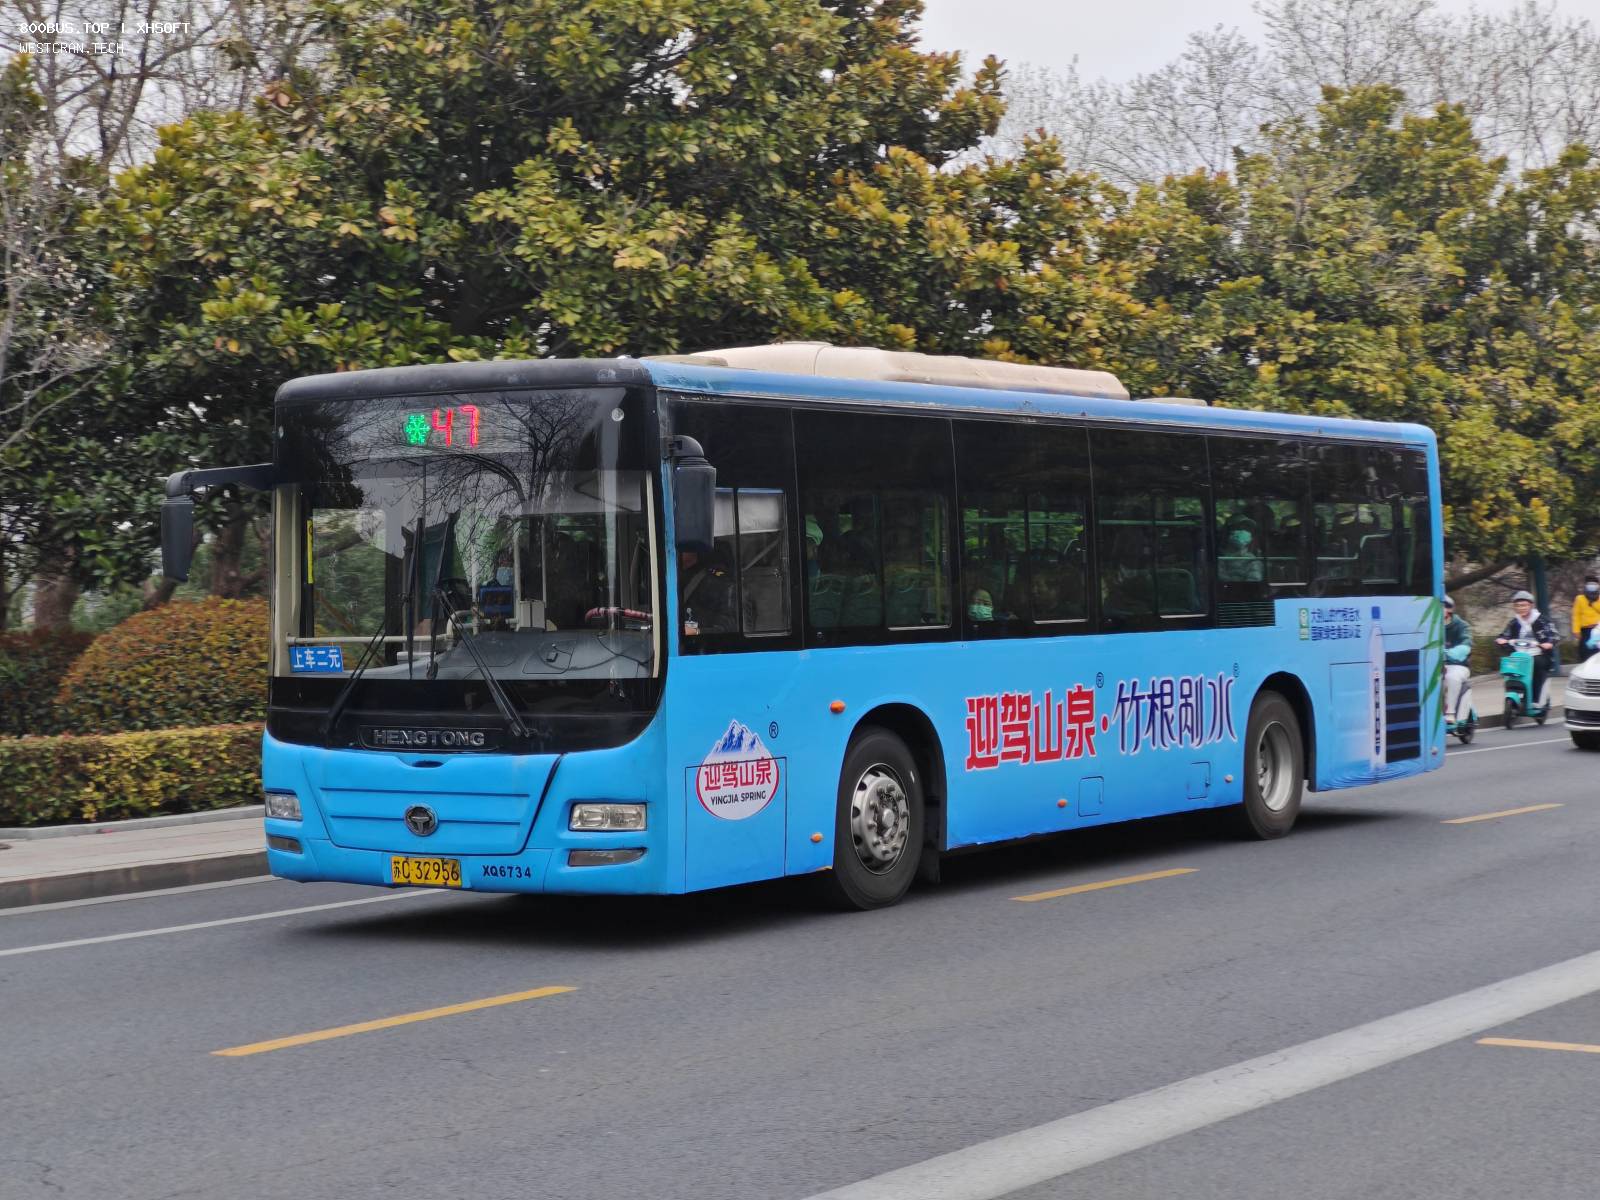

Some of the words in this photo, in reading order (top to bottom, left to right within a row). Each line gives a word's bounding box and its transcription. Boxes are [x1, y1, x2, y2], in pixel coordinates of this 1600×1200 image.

[432, 404, 480, 448] 47
[294, 648, 341, 669] 上车二元
[373, 729, 485, 747] HENGTONG
[966, 684, 1096, 771] 迎驾山泉
[704, 756, 771, 791] 迎驾山泉
[710, 793, 739, 806] YINGJIA
[740, 790, 767, 802] SPRING
[482, 865, 532, 878] XQ6734
